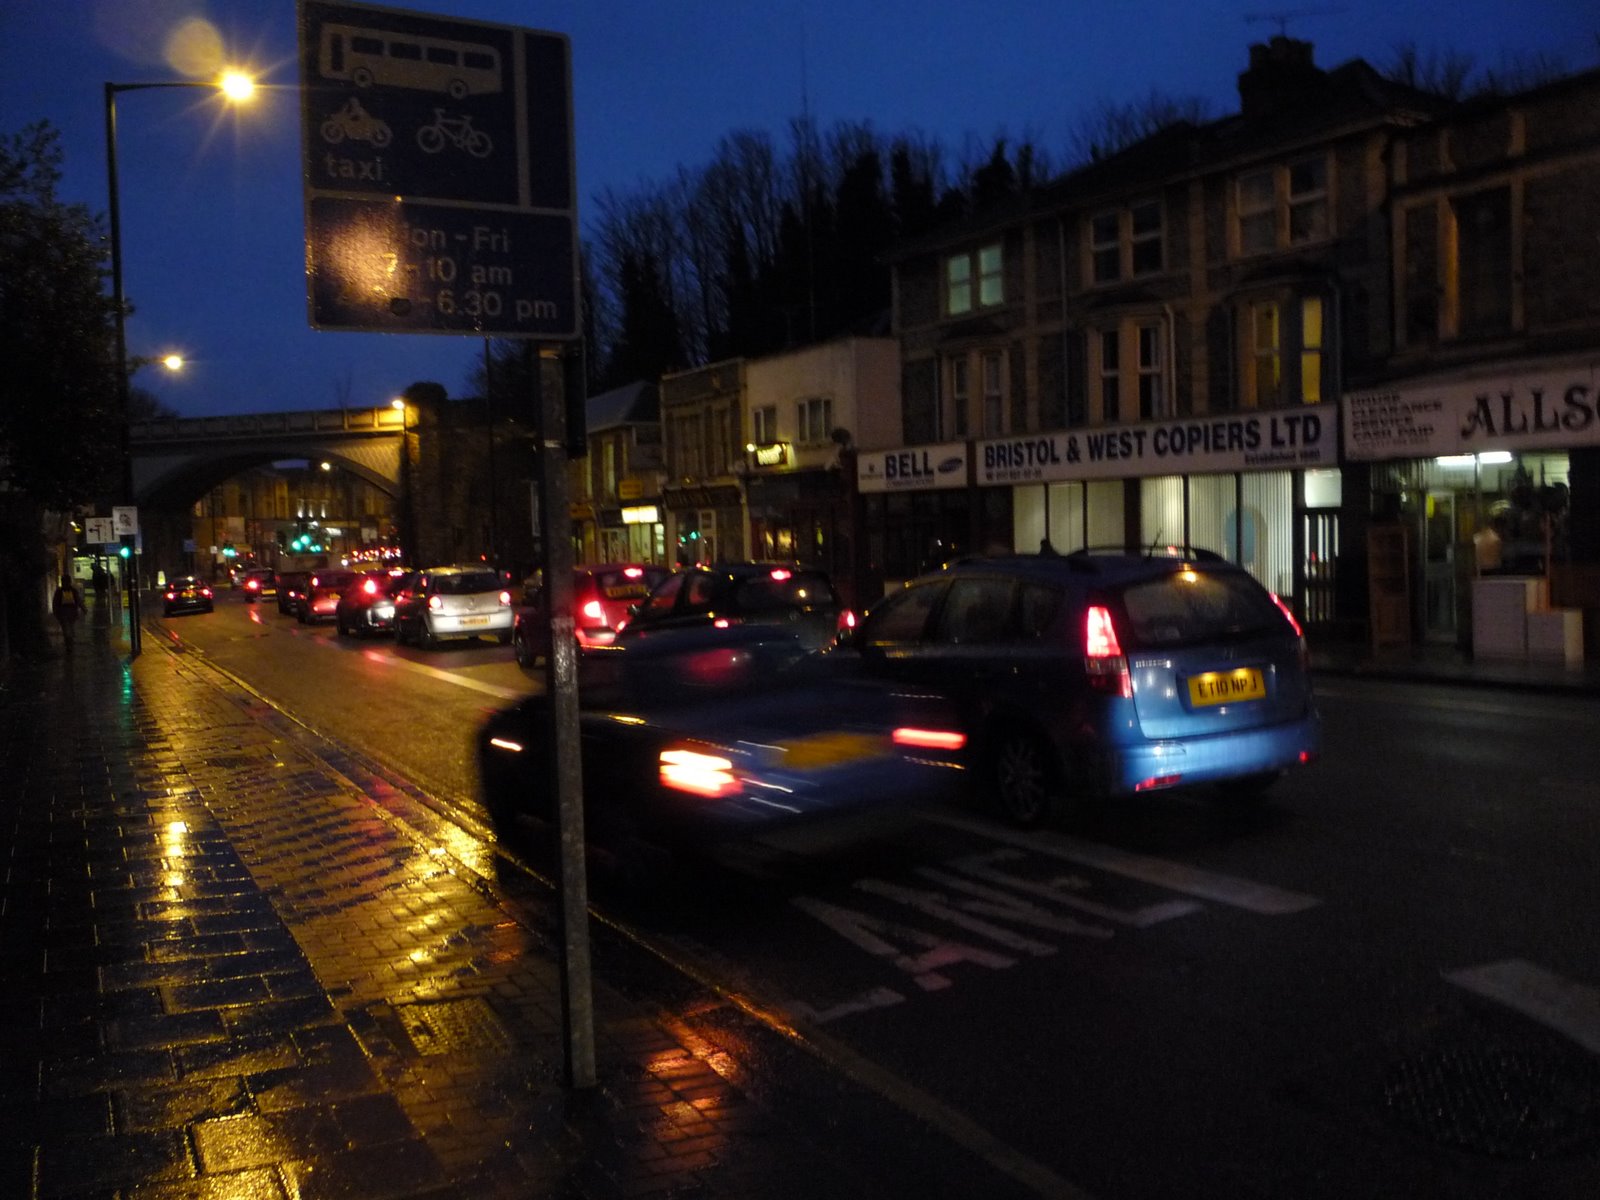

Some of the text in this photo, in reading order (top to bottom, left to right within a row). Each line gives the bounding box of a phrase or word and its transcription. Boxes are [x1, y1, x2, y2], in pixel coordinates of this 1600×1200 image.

[323, 152, 383, 181] taxi
[471, 268, 513, 286] am
[515, 299, 558, 321] pm
[984, 438, 1060, 469] BRISTOL
[1066, 435, 1081, 464] &
[1087, 429, 1147, 462] WEST
[1153, 418, 1261, 457] COPIERS
[1271, 413, 1321, 448] LTD
[885, 451, 935, 479] BELL
